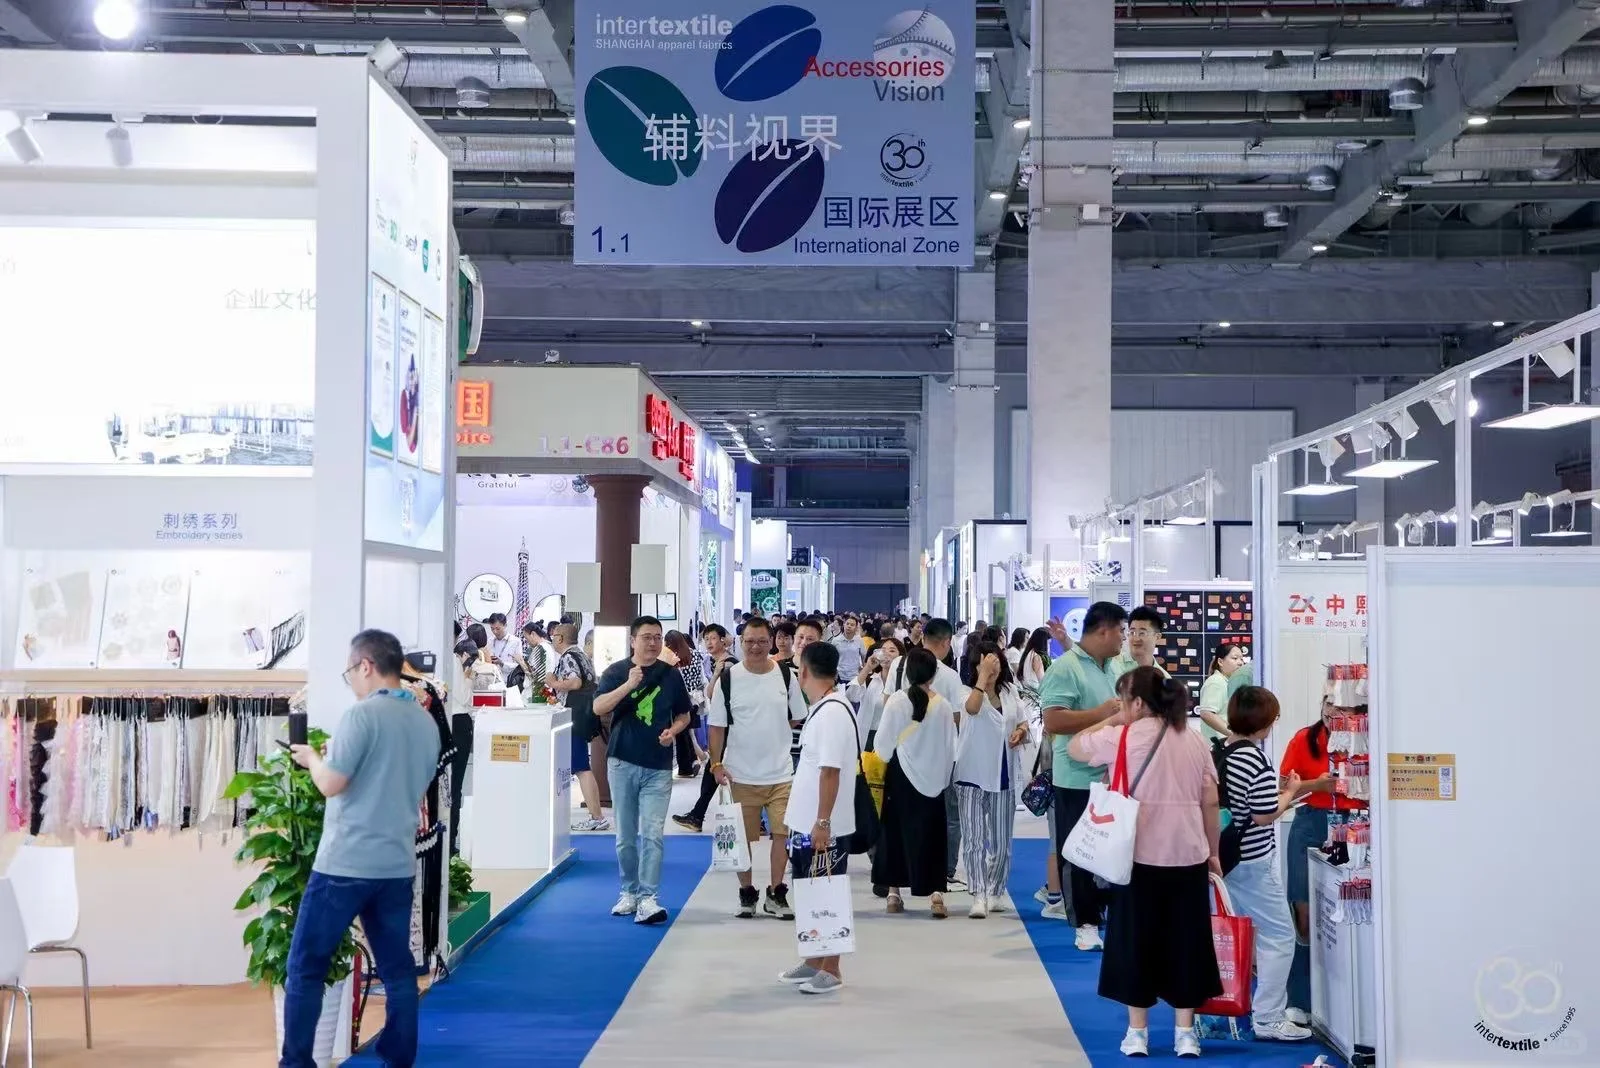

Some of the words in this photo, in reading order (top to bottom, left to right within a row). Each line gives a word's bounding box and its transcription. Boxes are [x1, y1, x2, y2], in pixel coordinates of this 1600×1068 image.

[596, 13, 734, 36] intertextile
[595, 39, 655, 50] SHANGHAI
[657, 40, 697, 52] apparel
[699, 39, 734, 50] fabrics
[804, 55, 945, 78] Accessories
[873, 80, 945, 102] Vision
[643, 113, 843, 163] 辅料视界
[823, 196, 960, 229] 国际展区
[591, 225, 630, 254] 1.1
[794, 236, 906, 254] International
[912, 236, 960, 254] Zone
[538, 435, 630, 455] 1.1-C86
[477, 481, 517, 489] Grateful
[163, 512, 238, 529] 刺绣系列
[156, 530, 211, 541] Embroidery
[214, 532, 243, 540] series
[1325, 620, 1347, 629] Zhong
